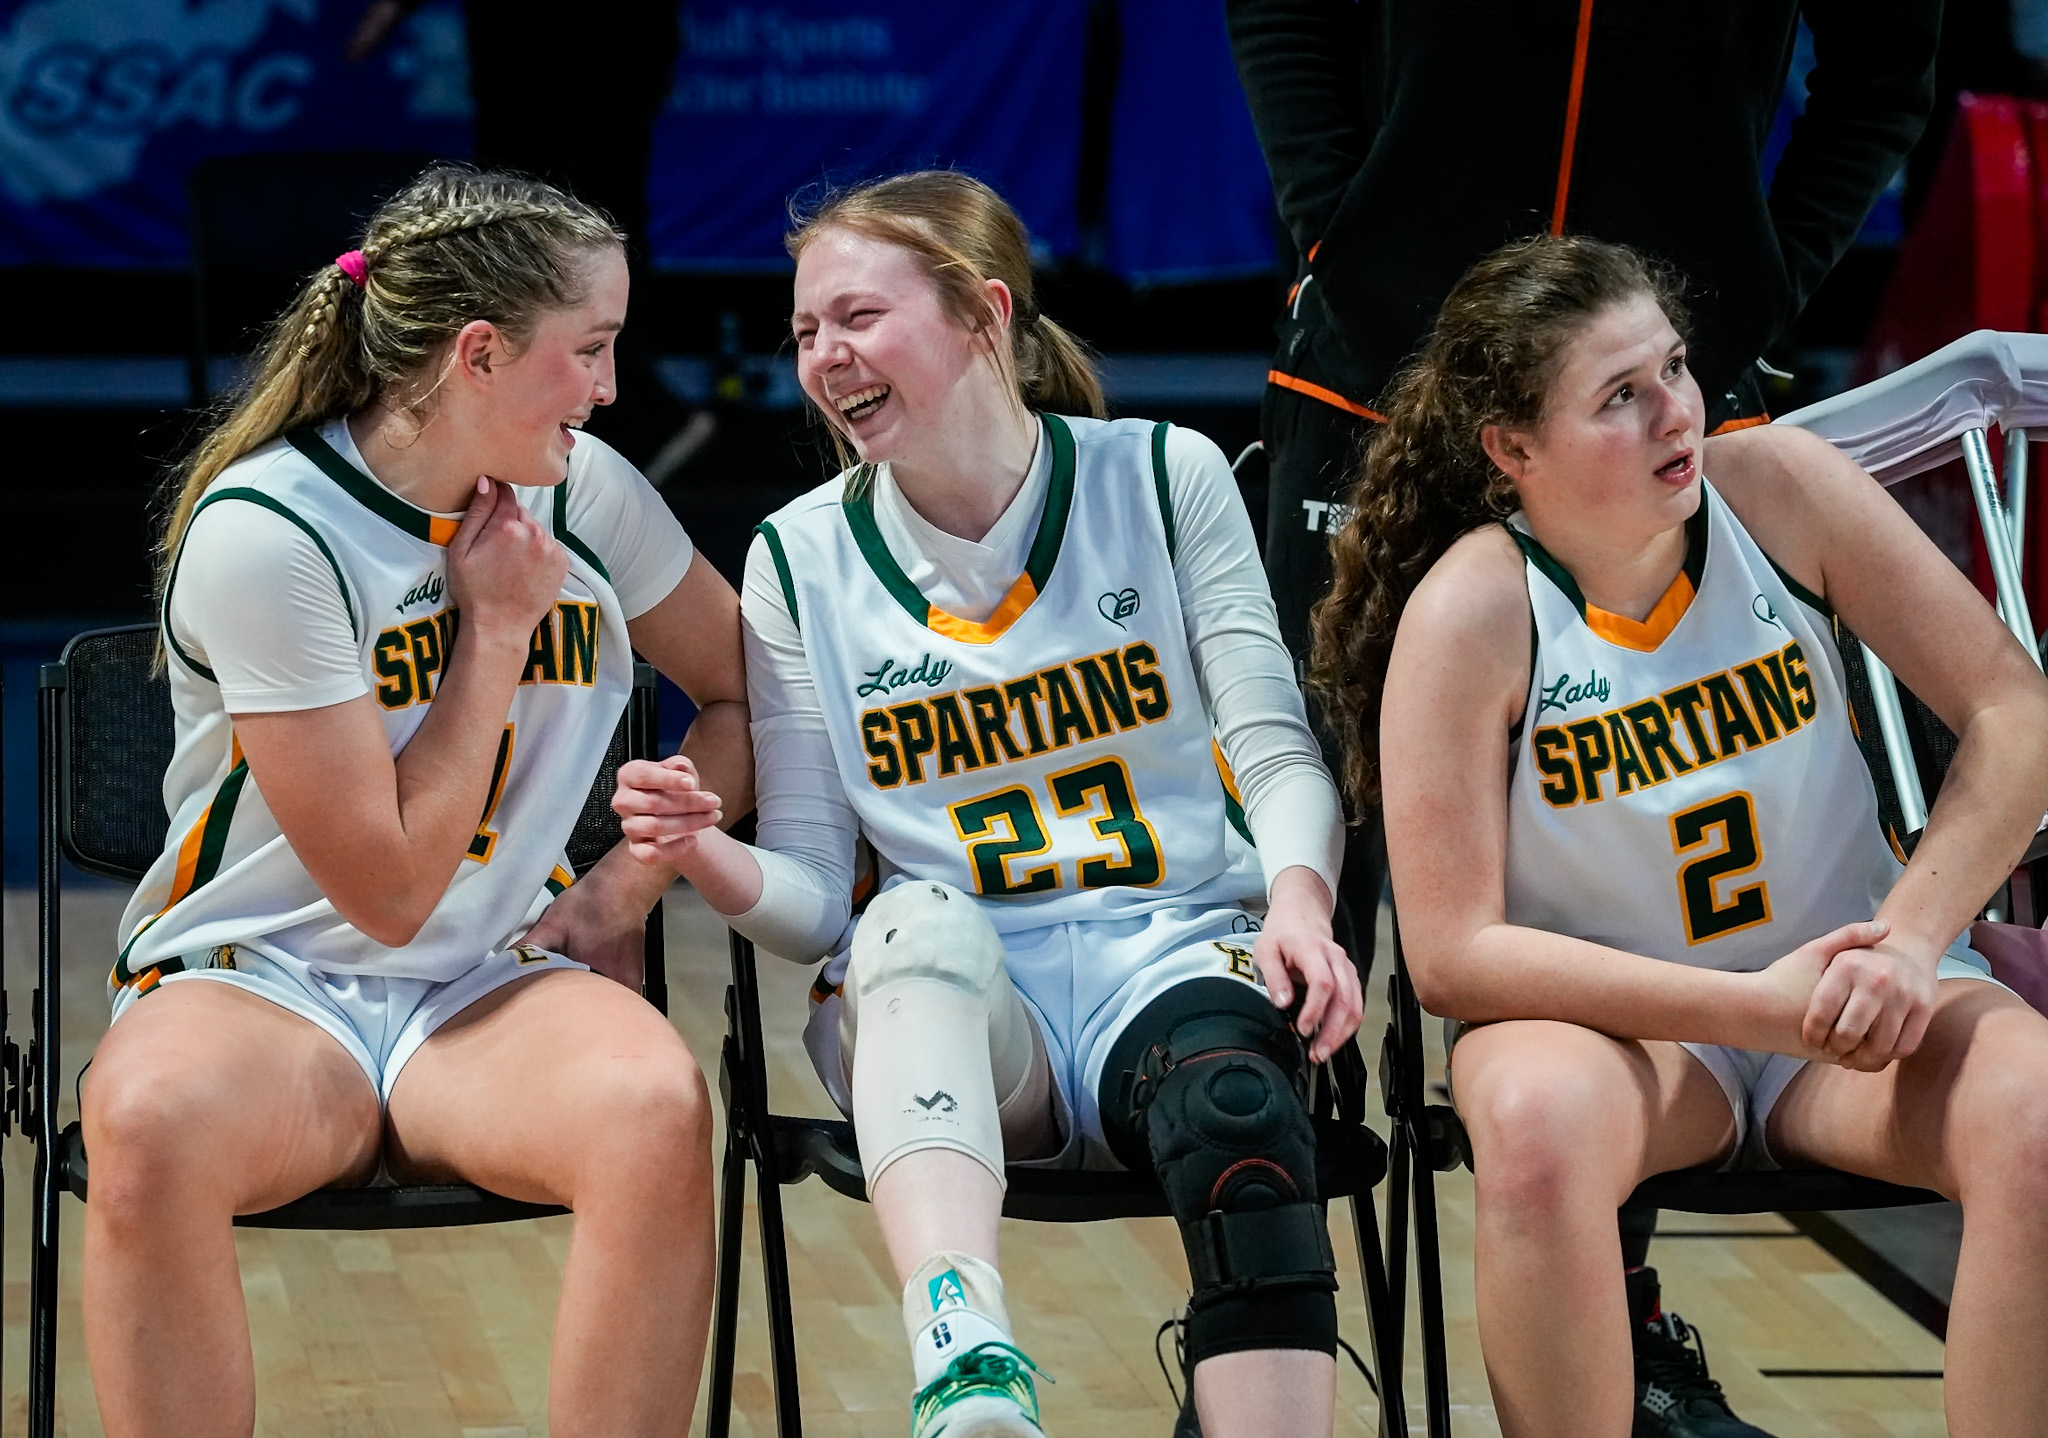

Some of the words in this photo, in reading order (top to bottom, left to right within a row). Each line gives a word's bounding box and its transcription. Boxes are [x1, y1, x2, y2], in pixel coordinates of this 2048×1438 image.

[12, 45, 315, 135] SSAC
[396, 571, 444, 614] ady
[371, 600, 600, 711] SPAN
[857, 653, 952, 697] Lady
[1541, 669, 1611, 712] Lady
[859, 640, 1172, 790] SPARTANS
[1531, 639, 1817, 808] SPARTANS
[947, 755, 1166, 896] 23
[1668, 790, 1773, 947] 2
